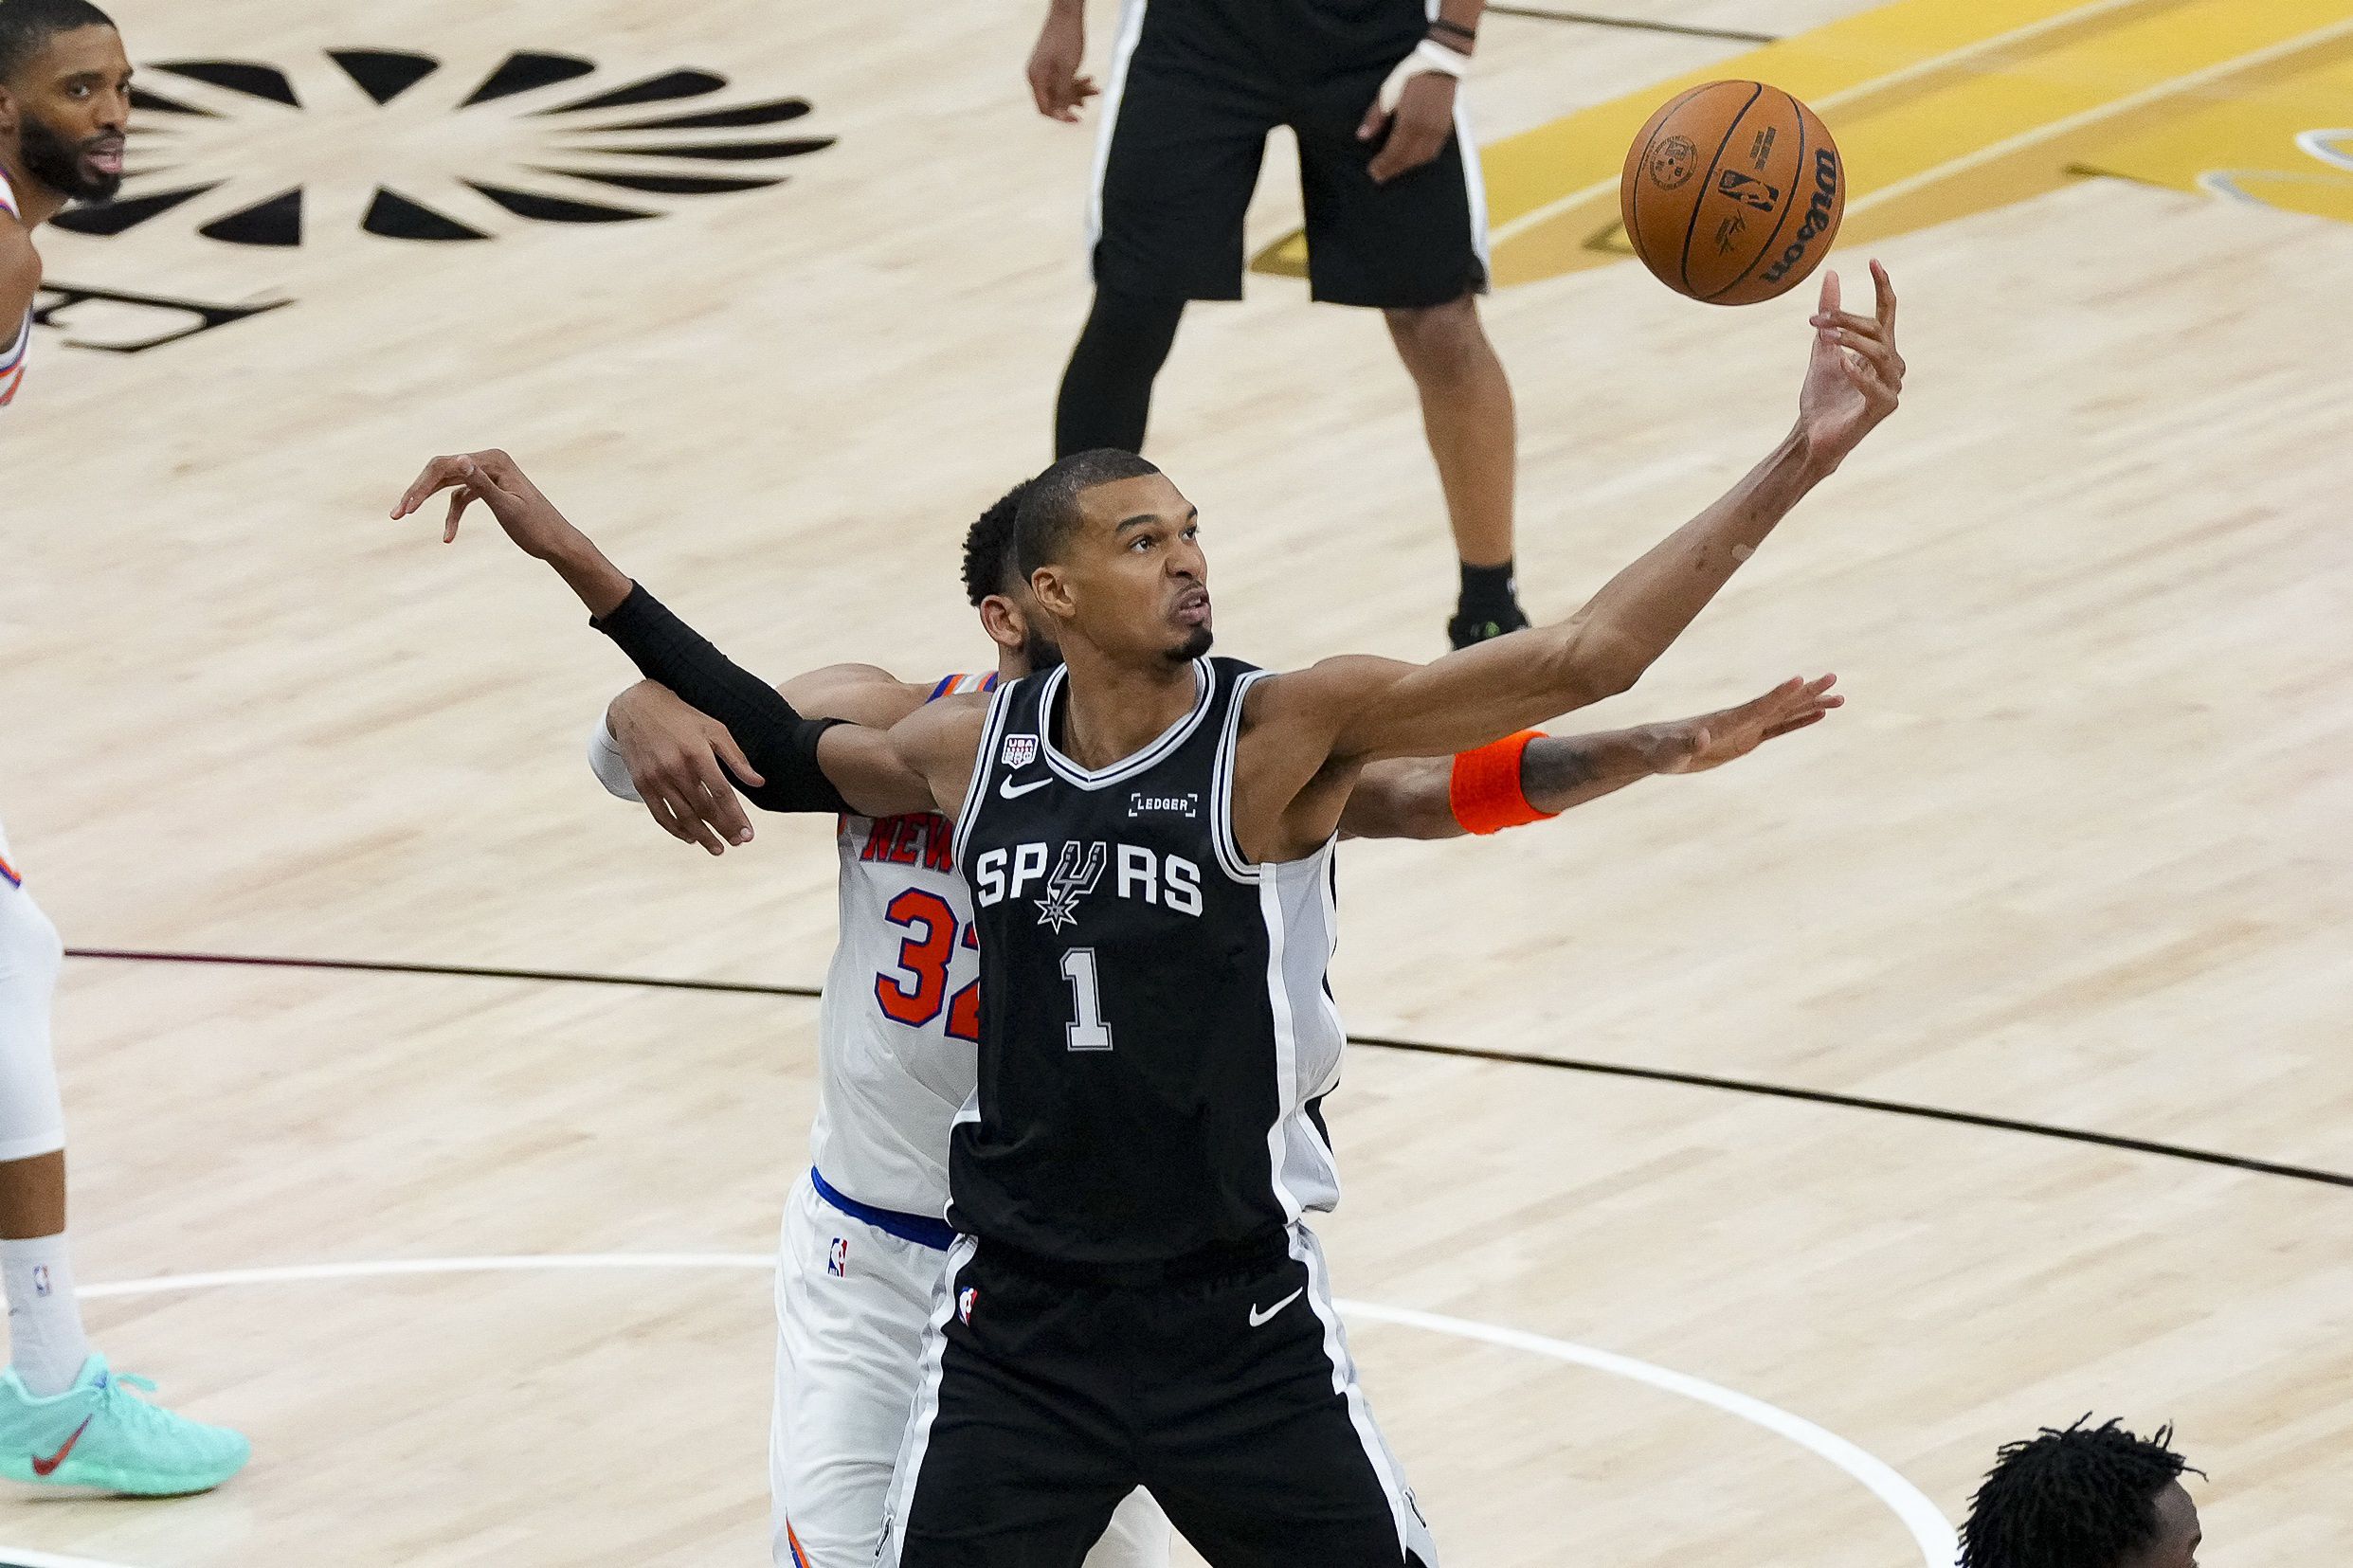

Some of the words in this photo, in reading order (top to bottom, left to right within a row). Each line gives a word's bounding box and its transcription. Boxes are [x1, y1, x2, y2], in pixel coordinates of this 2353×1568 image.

[1137, 798, 1188, 811] LEDGER
[977, 839, 1204, 935] SPURS
[1059, 947, 1113, 1052] 1
